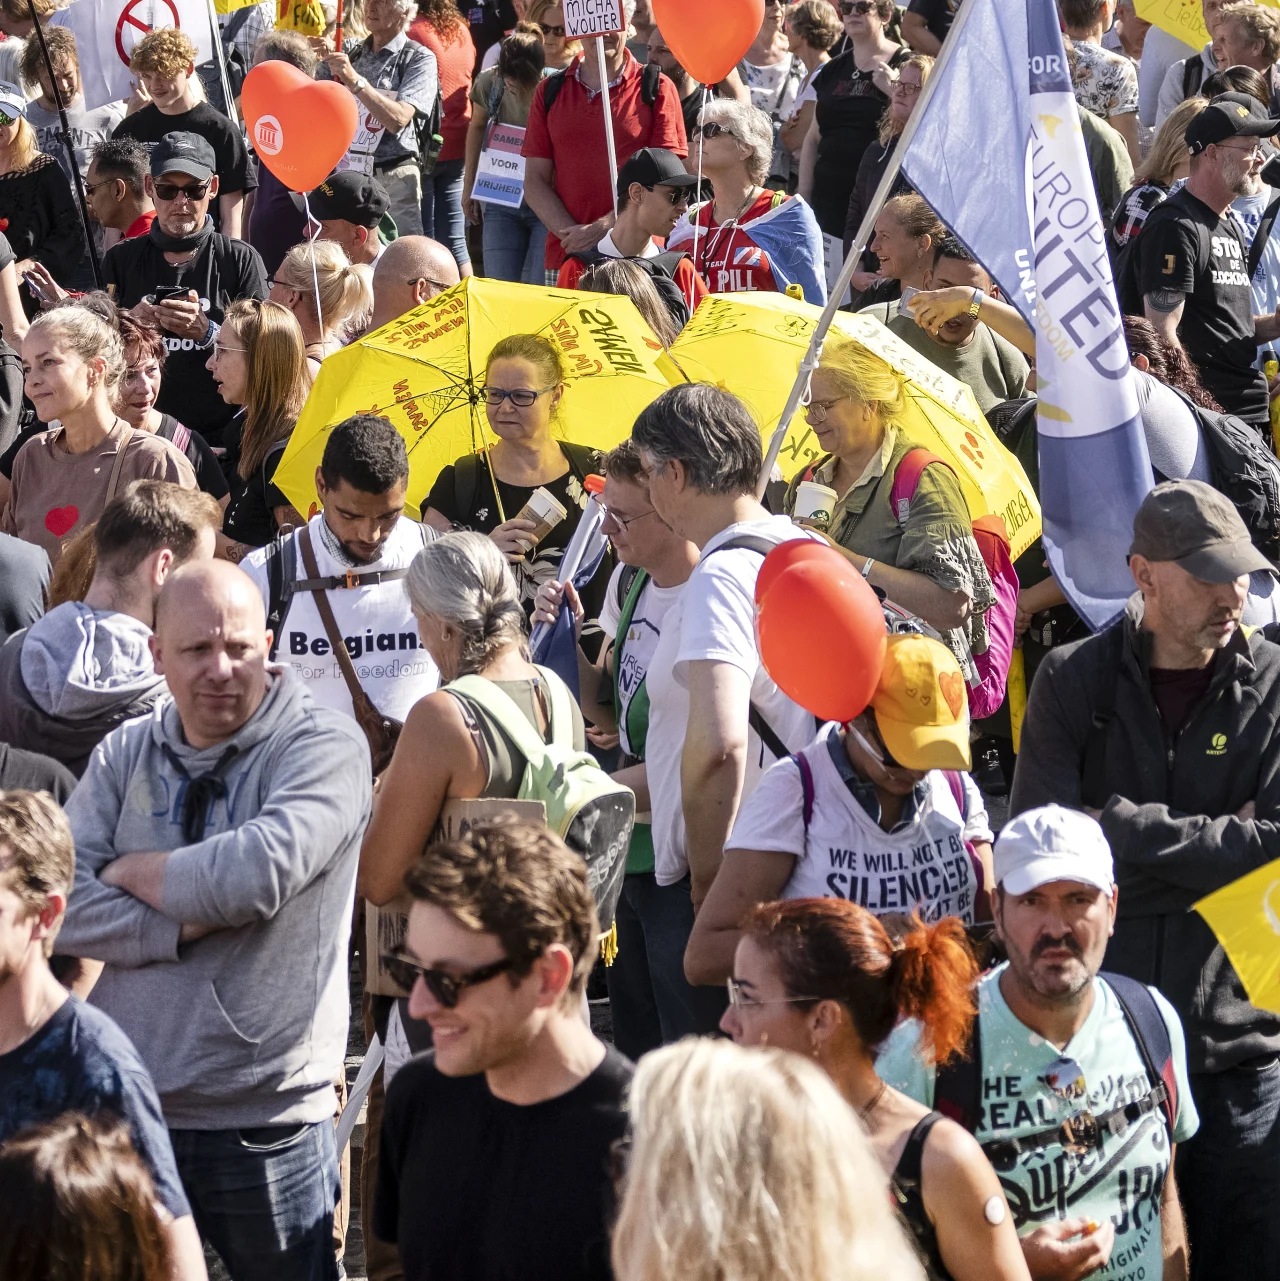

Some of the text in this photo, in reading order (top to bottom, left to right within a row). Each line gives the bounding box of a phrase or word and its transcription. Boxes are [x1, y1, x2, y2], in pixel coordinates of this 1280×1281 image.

[567, 12, 619, 37] WOUTER
[491, 157, 519, 171] VOOR
[477, 179, 522, 196] VRIJHEID
[1230, 259, 1241, 271] DE
[717, 269, 758, 292] PILL
[289, 628, 425, 660] Begian
[333, 659, 429, 679] Feedom
[829, 833, 964, 873] WE WILL NOT BE
[825, 856, 970, 909] SILENCED
[983, 1075, 1023, 1101] HE
[1099, 1226, 1152, 1275] RIGINAL
